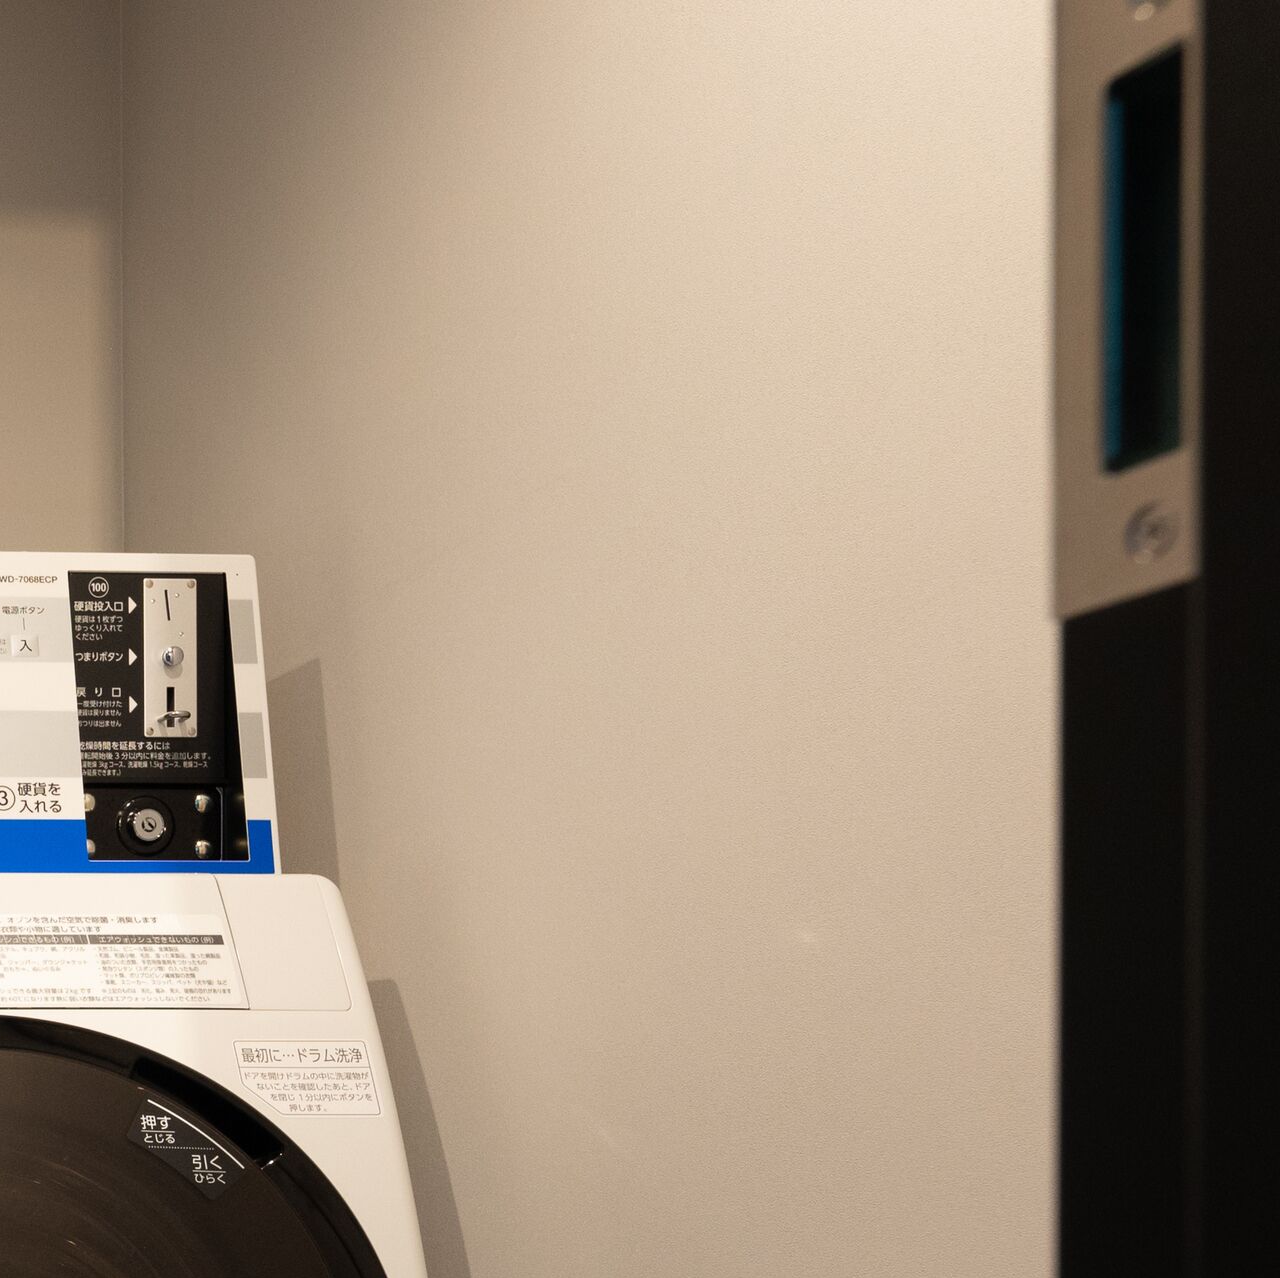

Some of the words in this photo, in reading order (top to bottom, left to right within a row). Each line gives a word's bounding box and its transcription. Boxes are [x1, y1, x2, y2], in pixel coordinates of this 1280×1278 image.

[91, 583, 106, 592] 100
[74, 601, 123, 612] 硬貨投入口
[20, 640, 32, 652] 入
[75, 652, 123, 661] つまりボタン
[18, 782, 61, 796] 硬貨を
[19, 799, 62, 813] 入れる
[141, 1115, 171, 1130] 押す
[144, 1134, 175, 1144] とじる
[192, 1155, 222, 1170] 引く
[194, 1173, 226, 1184] ひらく
